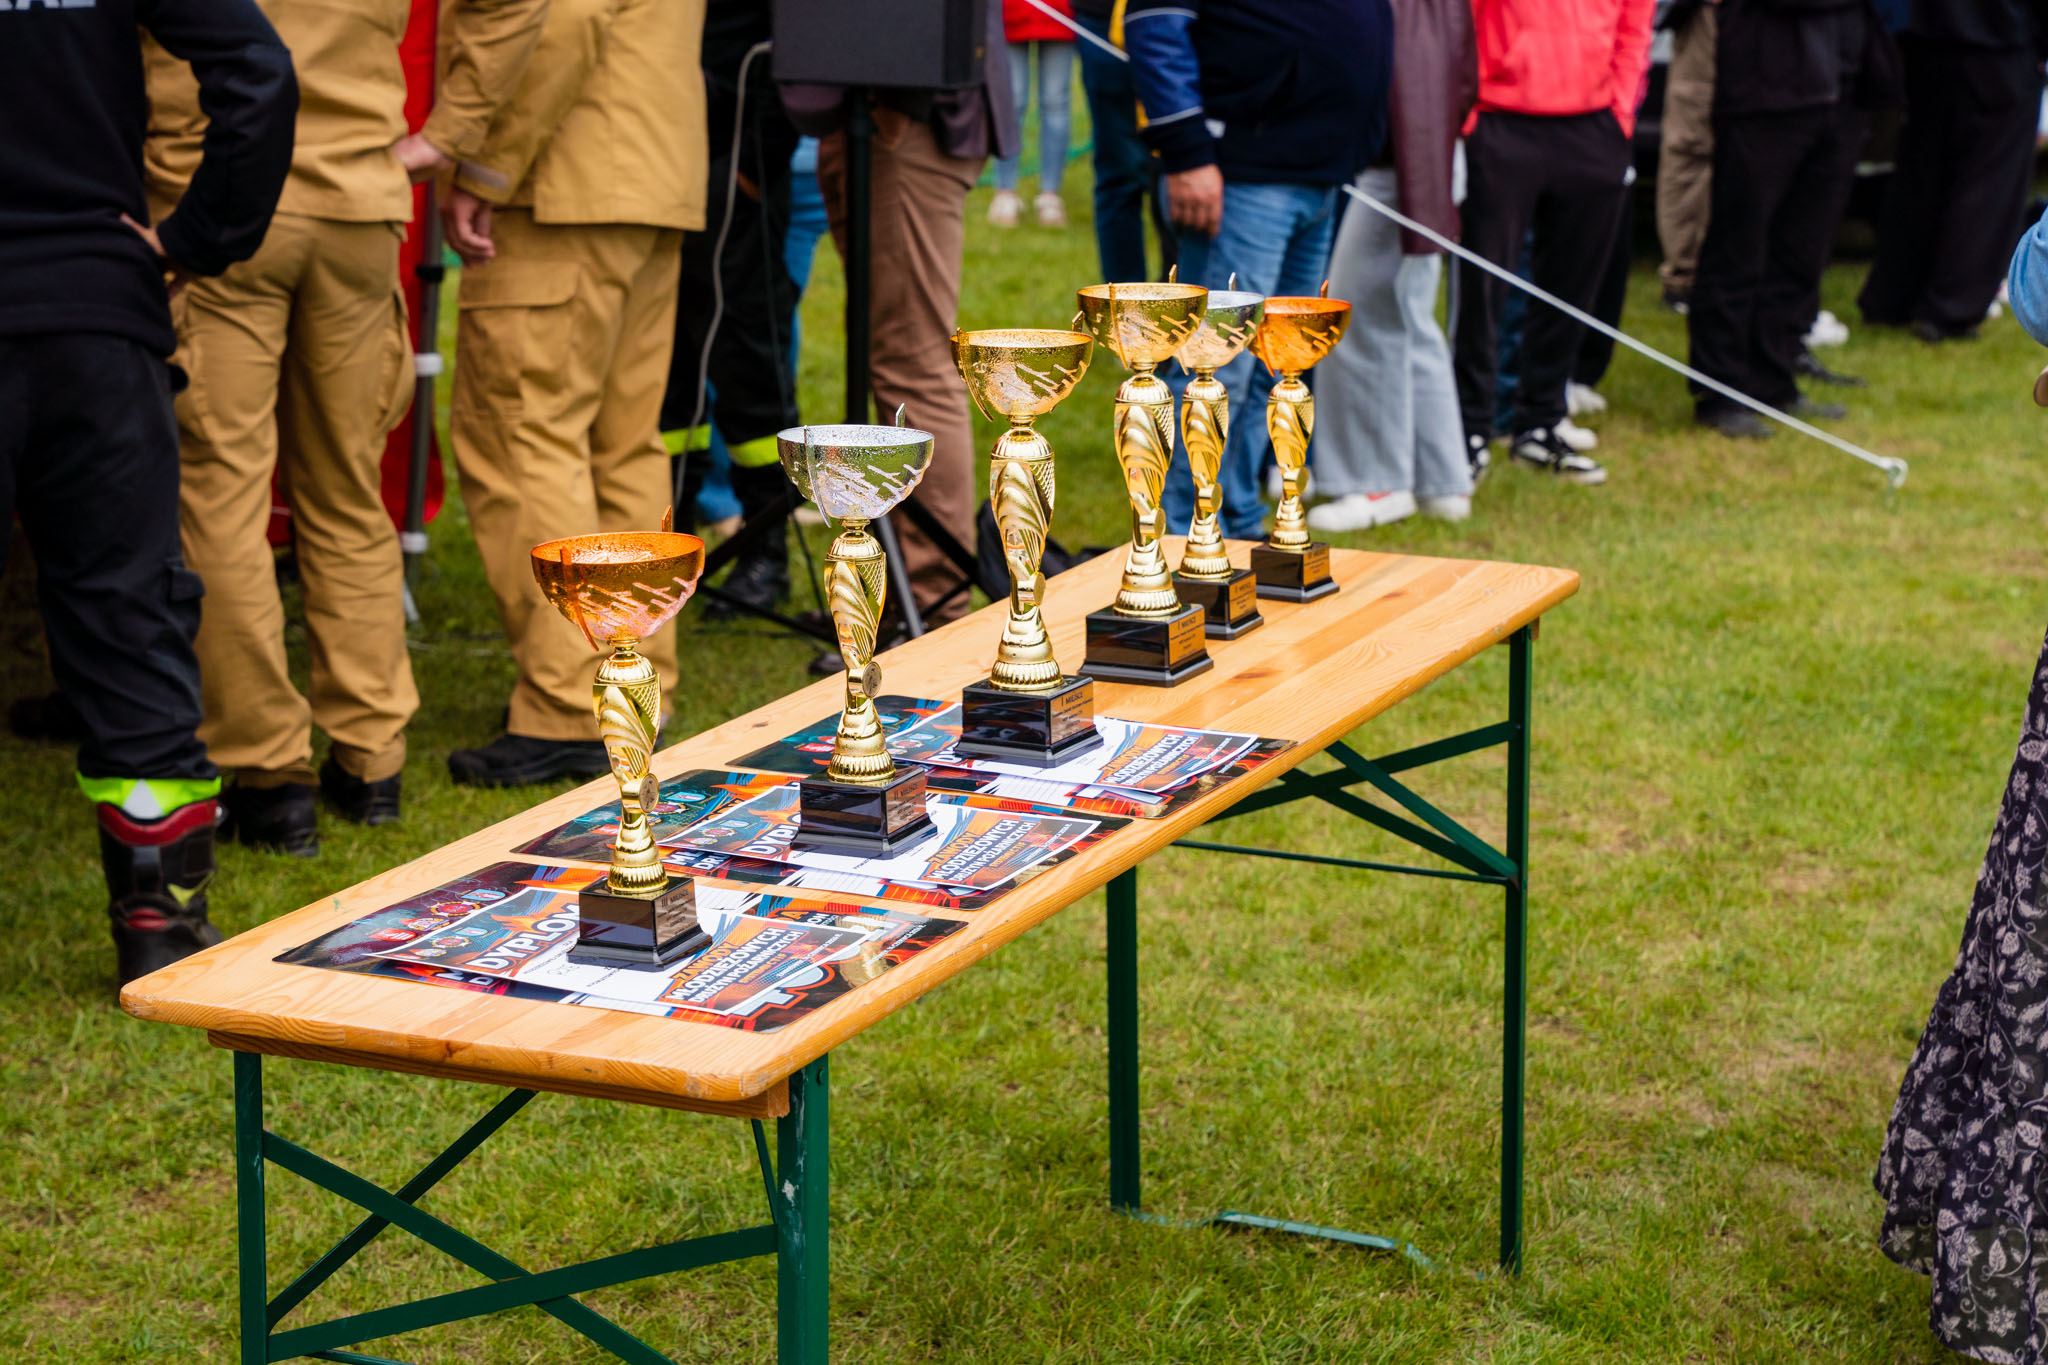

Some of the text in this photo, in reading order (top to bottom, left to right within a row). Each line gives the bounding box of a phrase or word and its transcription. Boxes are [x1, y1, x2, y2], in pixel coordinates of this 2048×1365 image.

[926, 819, 1019, 880] MŁODZIEŻOWYCH
[664, 927, 786, 999] MŁODZIEŻOWYCH
[673, 942, 739, 980] ZAWODY
